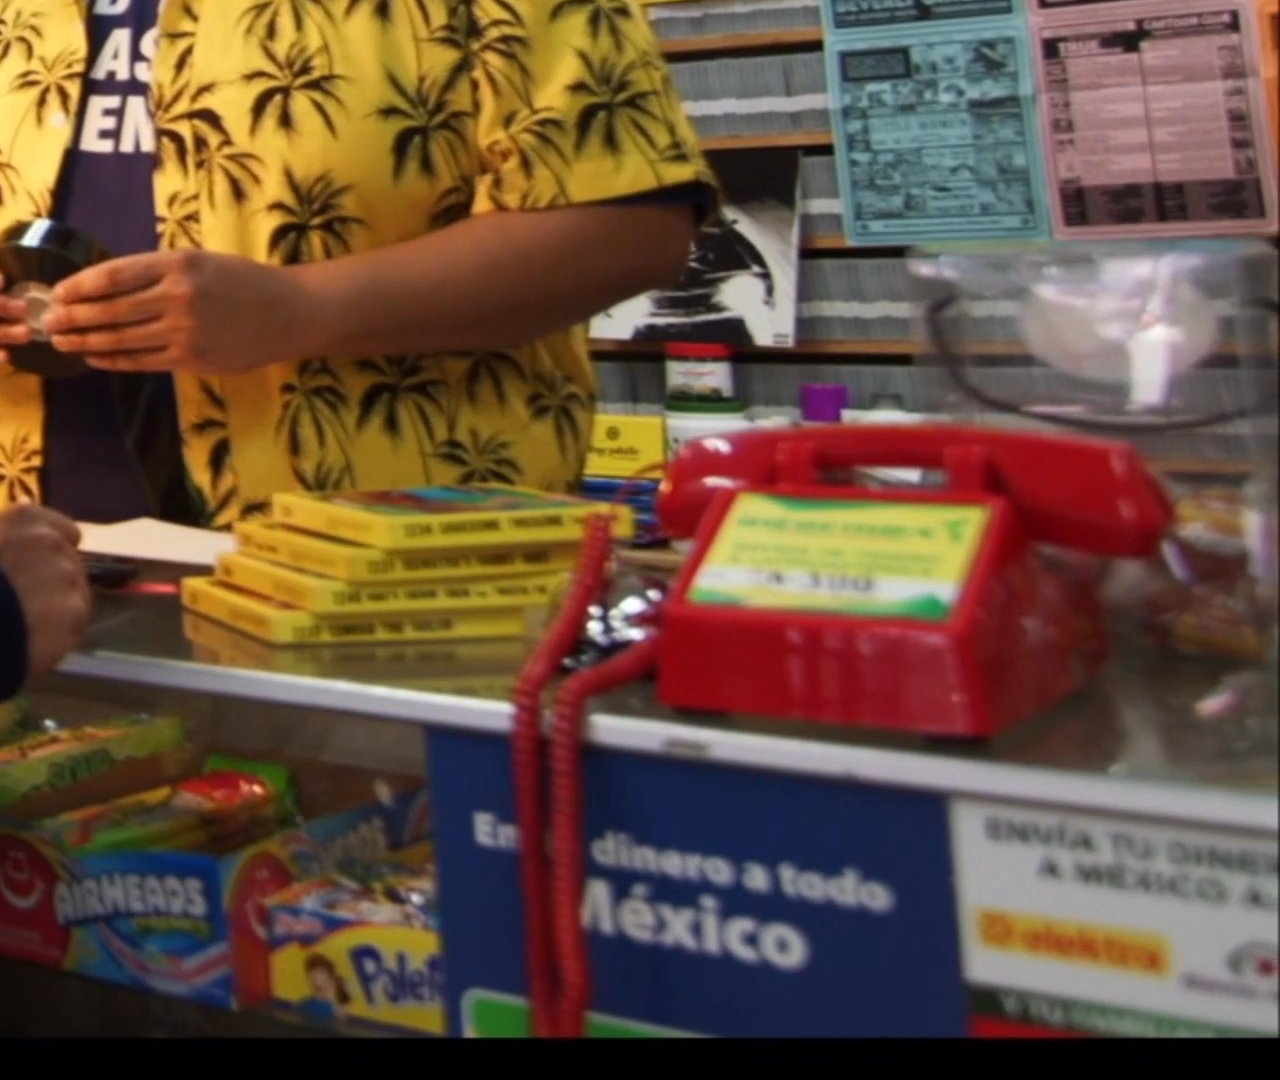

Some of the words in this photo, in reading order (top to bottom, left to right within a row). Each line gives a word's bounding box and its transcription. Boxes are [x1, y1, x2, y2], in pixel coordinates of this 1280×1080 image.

[985, 814, 1095, 855] ENVÍA
[1109, 831, 1157, 863] TU
[53, 871, 210, 924] AIRHEADS
[590, 831, 738, 889] dinero
[742, 860, 771, 895] a
[777, 860, 898, 916] todo
[1038, 856, 1064, 881] A
[1072, 862, 1231, 905] MÉXICO
[580, 876, 810, 973] México
[1019, 926, 1167, 977] elektra
